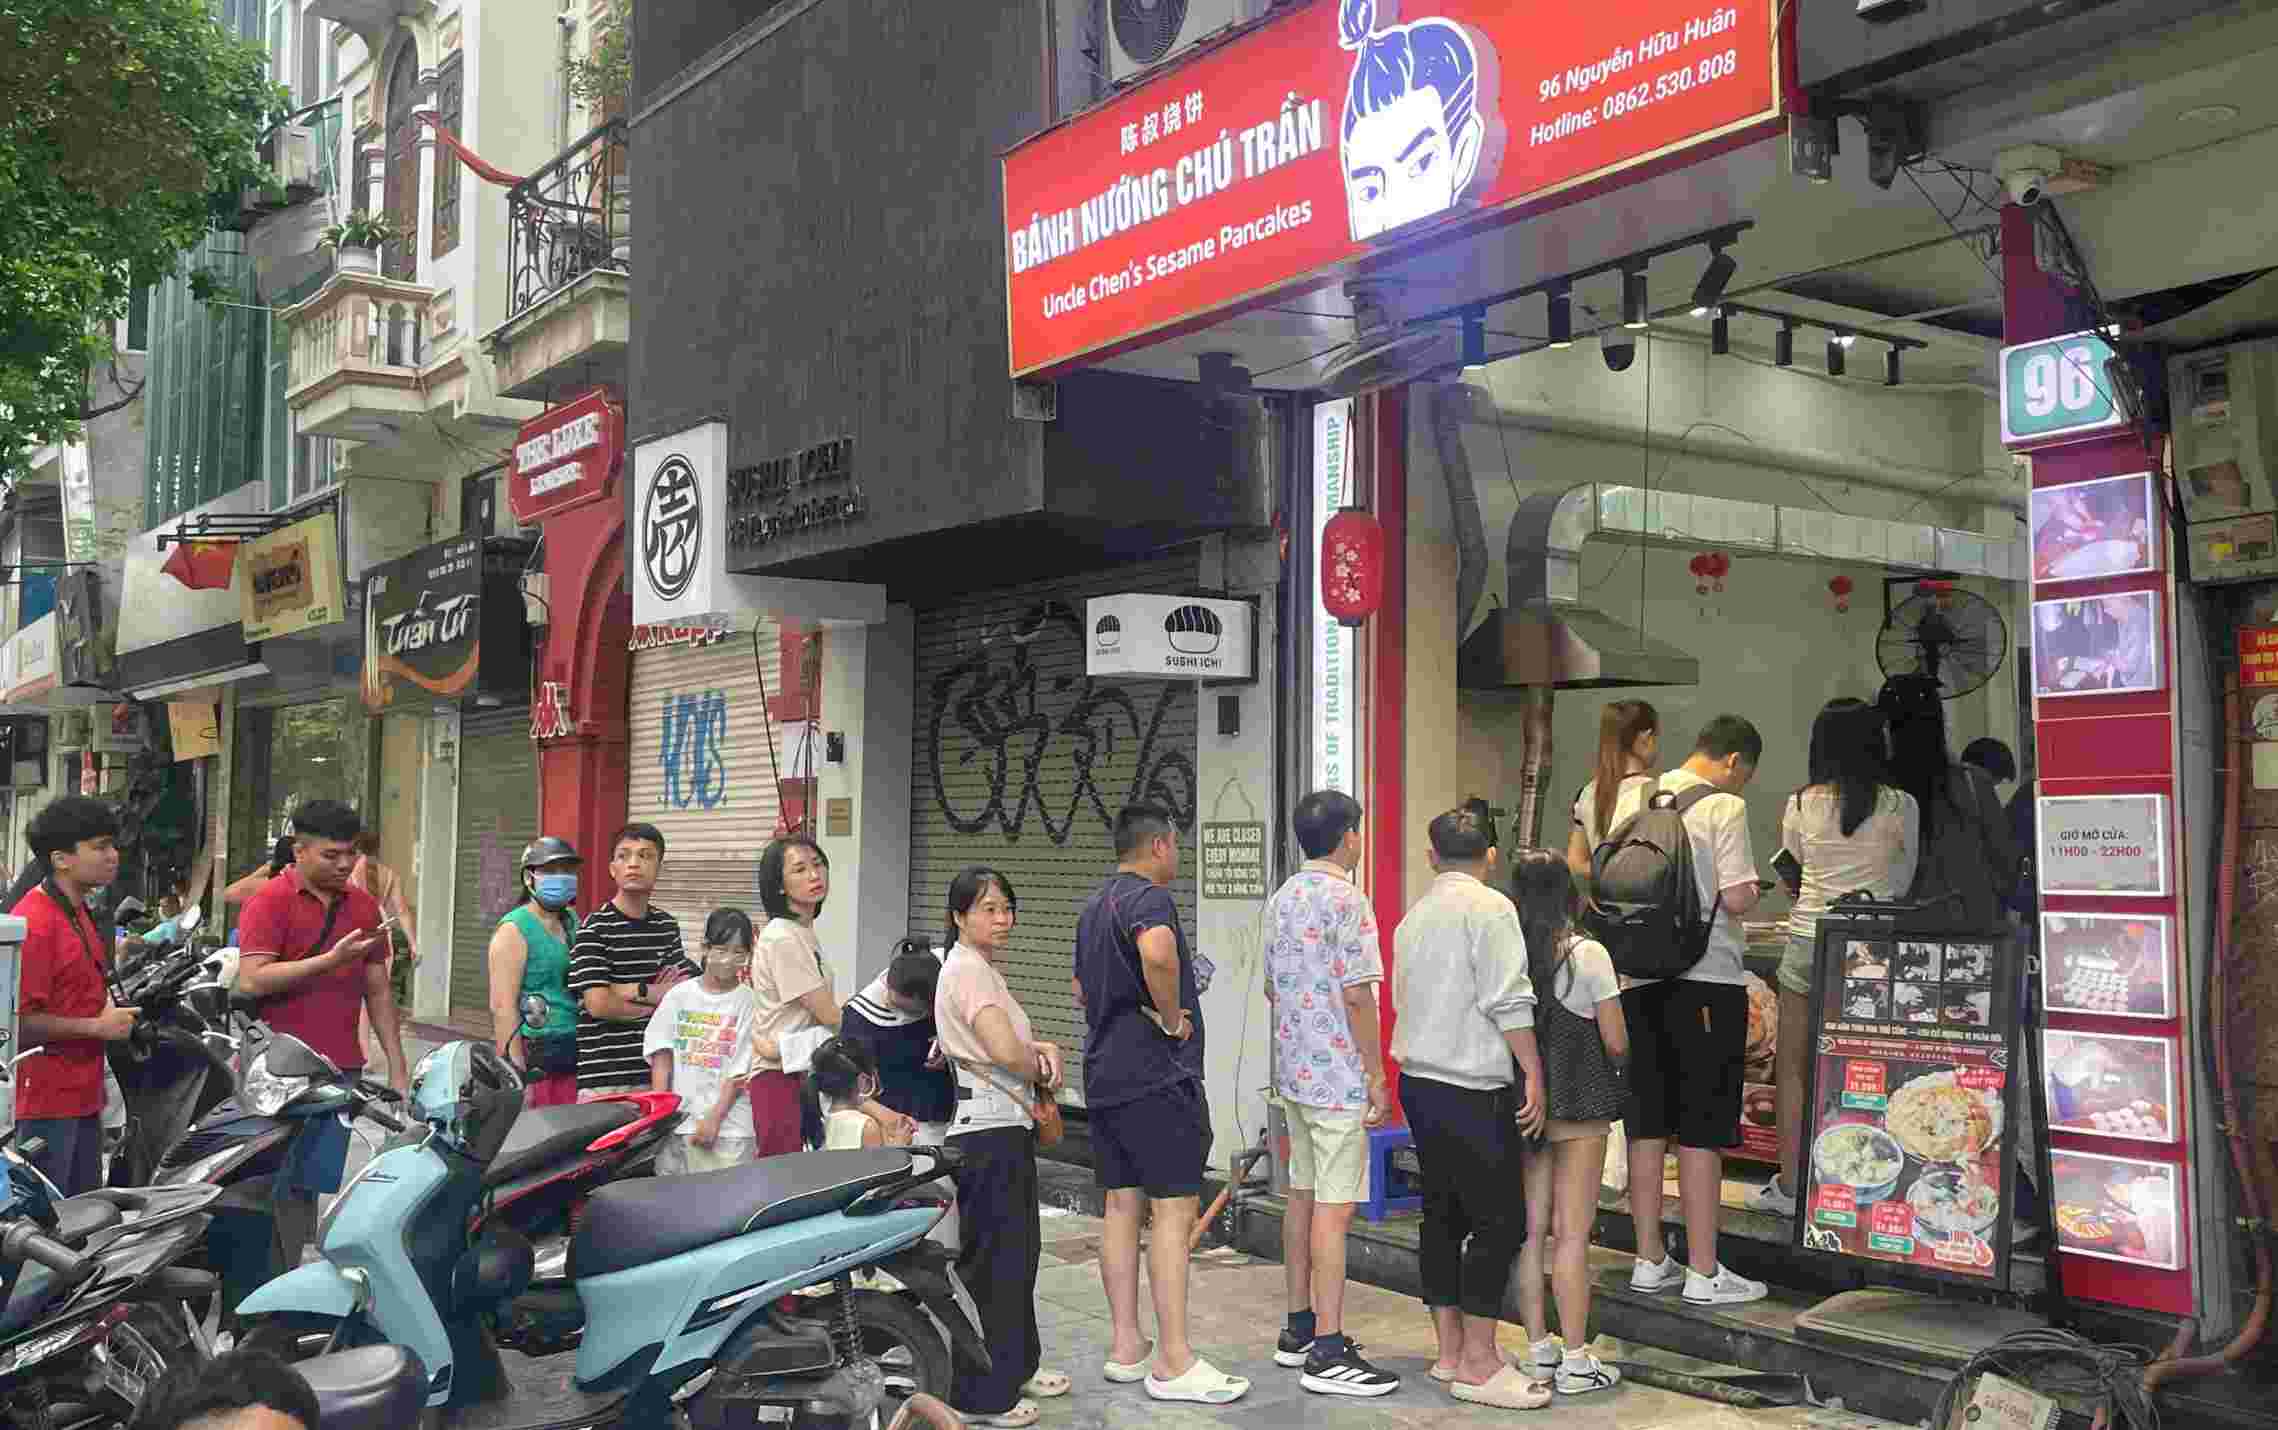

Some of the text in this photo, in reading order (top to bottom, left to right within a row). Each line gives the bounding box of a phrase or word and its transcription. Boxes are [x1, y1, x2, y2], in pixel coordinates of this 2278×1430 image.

[1529, 49, 1737, 147] Hotline: 0862.530.808
[1539, 74, 1561, 102] 96
[1638, 31, 1679, 64] Hữu
[1684, 8, 1736, 46] Huân
[1119, 90, 1204, 156] 陈叔烧饼
[1012, 90, 1321, 273] BÁNH NƯỚNG CHÚ TRẦN
[1042, 200, 1312, 319] Uncle Chen's Sesame Pancakes
[2023, 345, 2096, 417] 96
[1326, 416, 1341, 513] MANSHIP
[1165, 656, 1222, 669] SUSHI ICHI
[1326, 617, 1341, 723] TRADITION
[1326, 733, 1340, 756] OF
[2050, 846, 2089, 857] 11H00
[2100, 846, 2142, 857] 22H00
